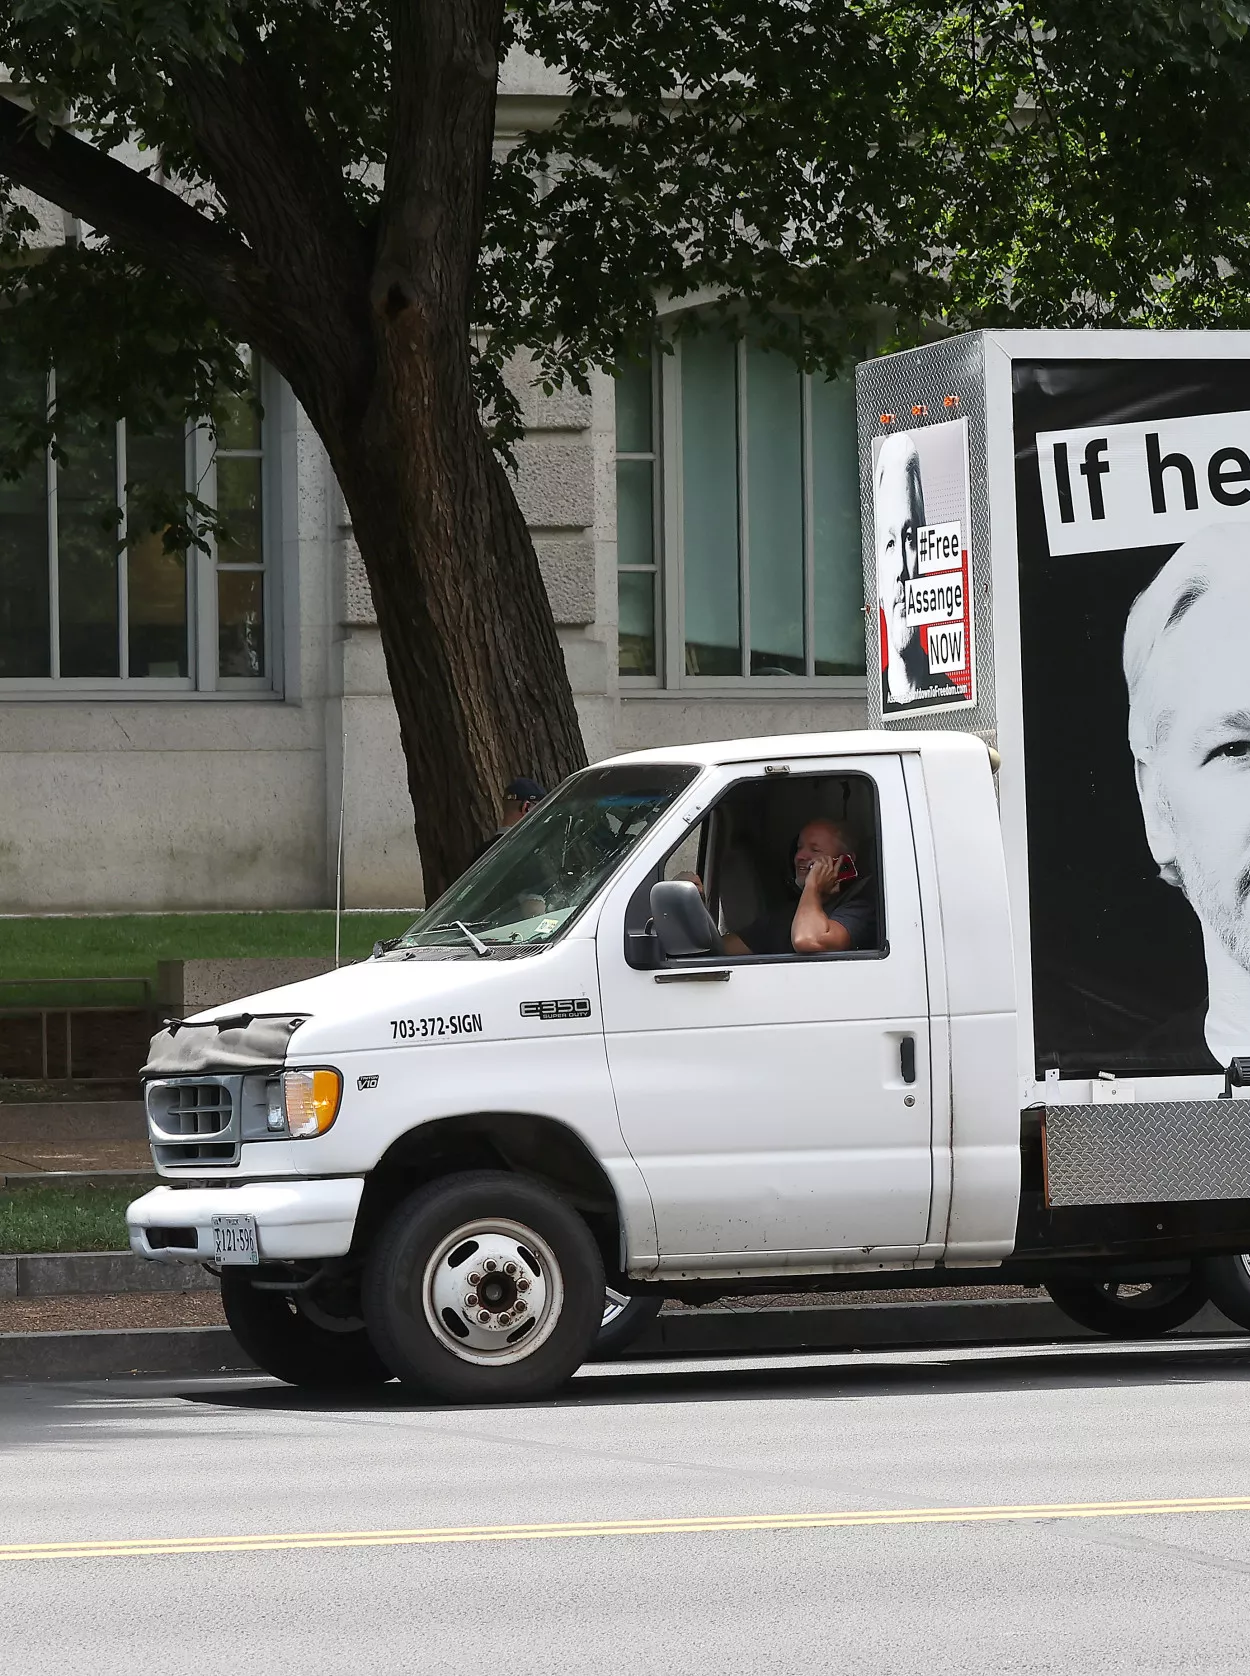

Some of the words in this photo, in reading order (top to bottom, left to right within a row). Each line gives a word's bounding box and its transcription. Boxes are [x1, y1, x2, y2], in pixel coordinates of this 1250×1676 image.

[1053, 438, 1109, 523] If
[919, 530, 959, 562] #Free
[908, 584, 962, 617] Assange
[930, 631, 962, 666] NOW
[390, 1014, 483, 1039] 703-372-SIGN
[358, 1079, 377, 1090] V10
